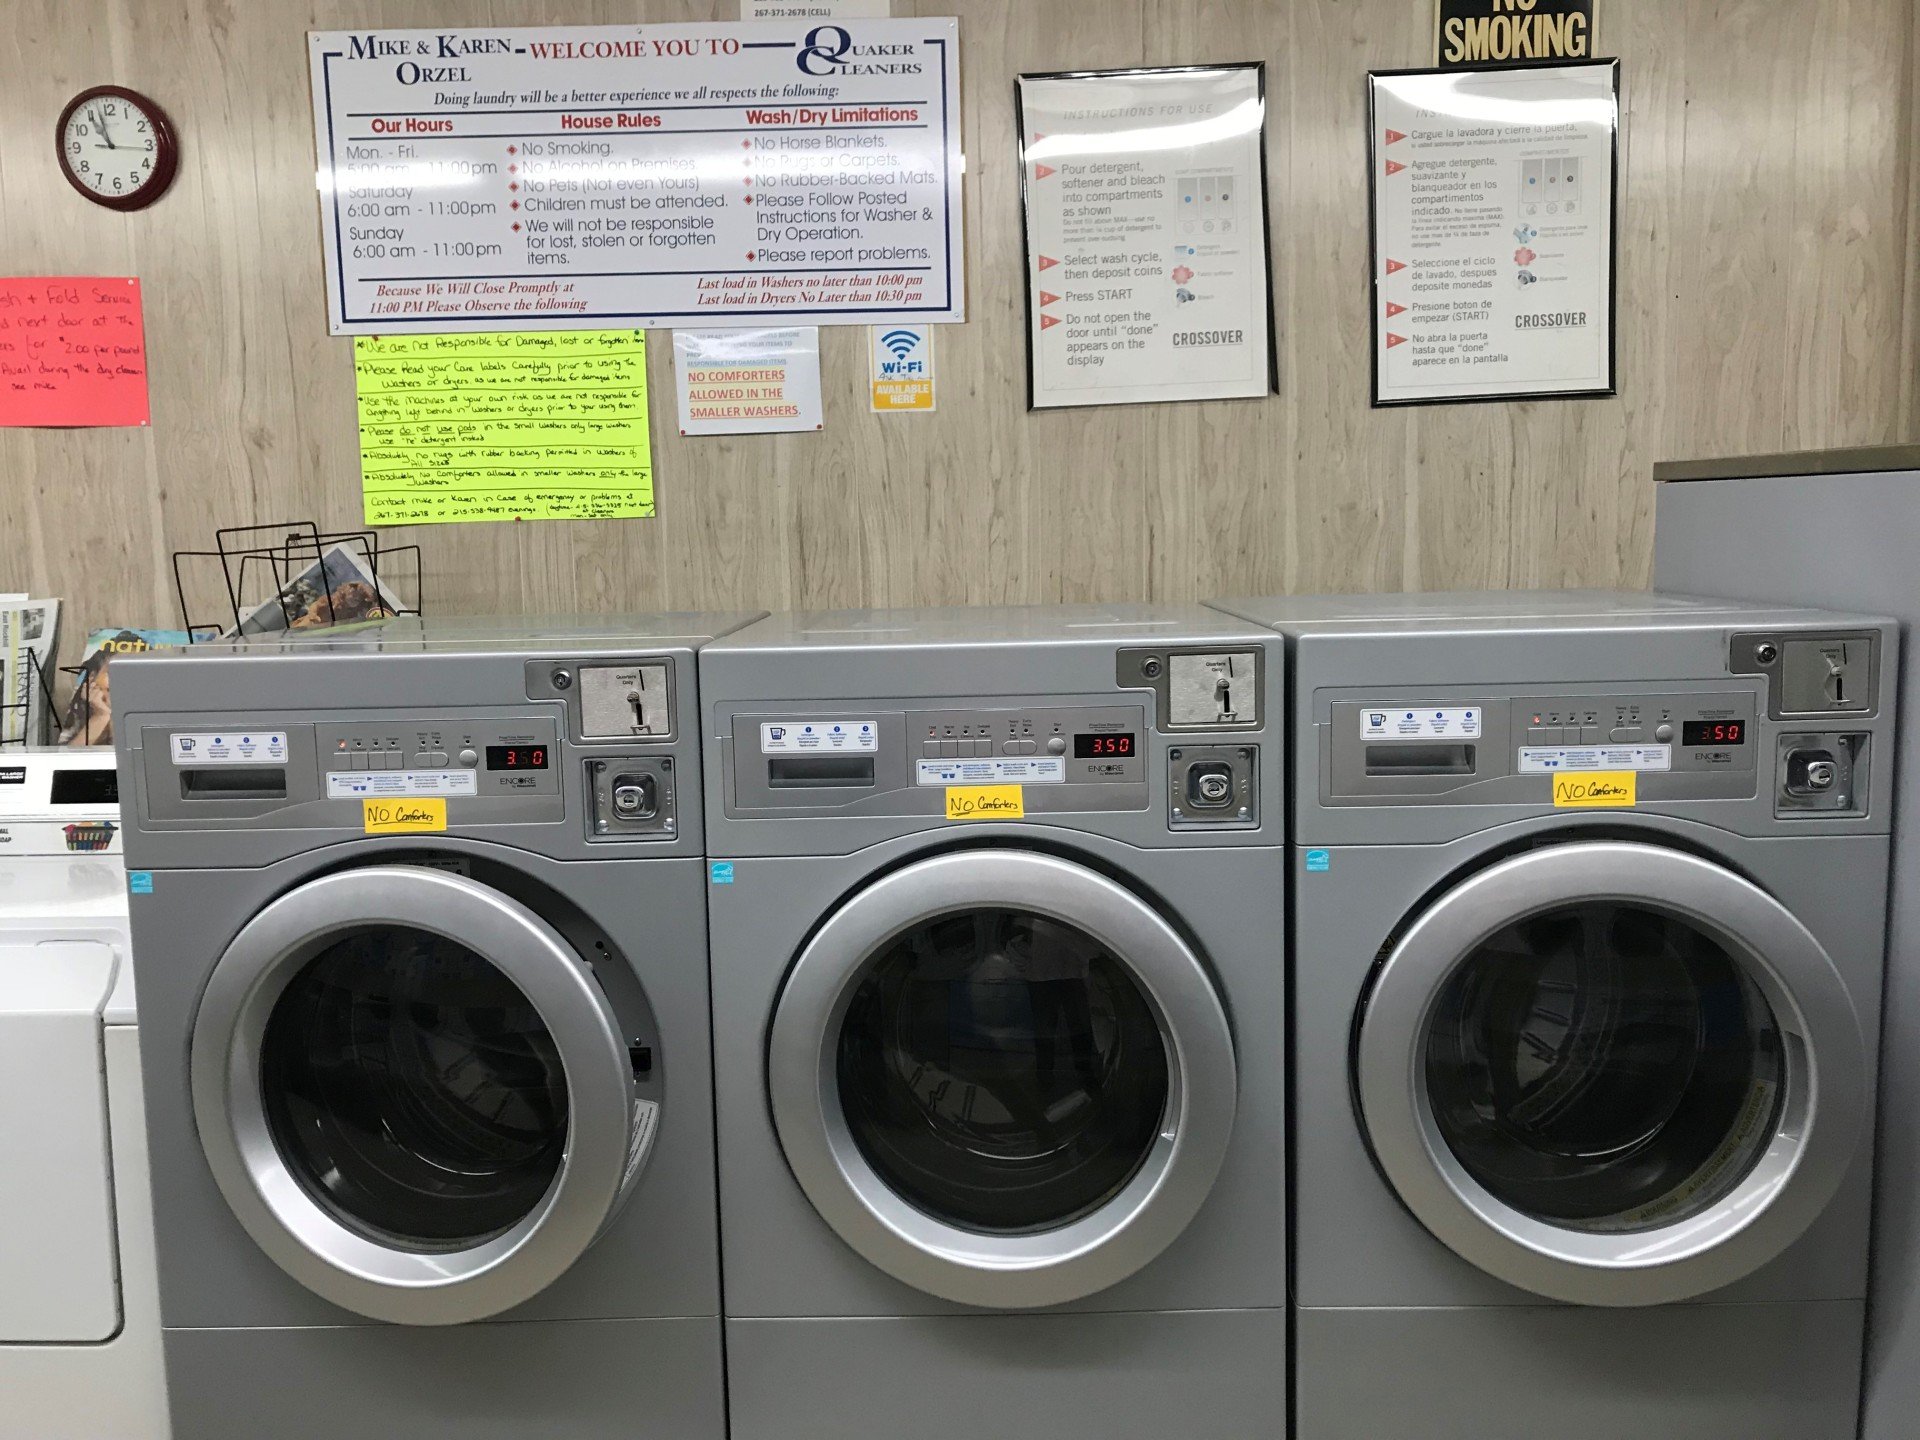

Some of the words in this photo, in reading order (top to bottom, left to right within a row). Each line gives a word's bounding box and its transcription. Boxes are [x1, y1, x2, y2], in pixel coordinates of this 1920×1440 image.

[808, 8, 831, 17] (CELL)
[1444, 12, 1586, 62] SMOKING
[416, 40, 430, 55] &
[530, 41, 646, 60] WELCOME
[650, 39, 701, 57] YOU
[704, 38, 739, 55] TO
[434, 92, 469, 108] Doing
[473, 92, 517, 108] laundry
[520, 91, 541, 104] will
[544, 90, 559, 103] be
[561, 94, 568, 103] a
[570, 90, 606, 103] better
[609, 87, 672, 104] experience
[675, 90, 689, 100] we
[692, 87, 707, 99] all
[710, 86, 757, 102] respects
[760, 85, 779, 98] the
[782, 83, 839, 101] following:
[103, 103, 116, 117] 12
[124, 107, 129, 120] 1
[746, 109, 828, 126] Wash/Dry
[831, 107, 918, 123] Limitations
[136, 120, 146, 133] 2
[371, 118, 401, 133] Our
[405, 118, 453, 133] Hours
[561, 114, 613, 129] House
[617, 113, 662, 128] Rules
[75, 124, 89, 137] 10
[72, 141, 82, 154] 9
[144, 139, 154, 152] 3
[522, 142, 544, 156] No
[547, 140, 614, 158] Smoking.
[80, 160, 90, 173] 8
[141, 157, 151, 170] 4
[1061, 163, 1086, 175] Pour
[1089, 162, 1144, 175] detergent,
[95, 172, 104, 185] 7
[112, 177, 122, 190] 6
[130, 171, 140, 184] 5
[1062, 178, 1103, 189] softener
[1106, 176, 1127, 187] and
[1130, 174, 1166, 186] bleach
[524, 197, 586, 212] Children
[590, 198, 626, 210] must
[630, 196, 650, 209] be
[655, 194, 728, 209] attended.
[756, 193, 804, 207] Please
[808, 192, 854, 206] Follow
[858, 191, 907, 205] Posted
[1062, 192, 1083, 203] into
[1086, 189, 1163, 203] compartments
[347, 203, 380, 218] 6:00
[385, 206, 410, 217] am
[756, 209, 837, 224] Instructions
[840, 209, 860, 222] for
[864, 207, 917, 222] Washer
[922, 207, 933, 221] &
[1062, 208, 1075, 217] as
[1078, 205, 1112, 216] shown
[525, 219, 549, 233] We
[552, 218, 574, 232] will
[578, 218, 602, 232] not
[605, 217, 627, 231] be
[631, 215, 714, 233] responsible
[349, 227, 404, 242] Sunday
[526, 235, 545, 249] for
[549, 235, 577, 250] lost,
[582, 233, 624, 248] stolen
[629, 237, 646, 247] or
[648, 232, 716, 249] forgotten
[353, 244, 386, 259] 6:00
[390, 247, 416, 258] am
[527, 251, 570, 265] items.
[1064, 254, 1098, 266] Select
[1101, 253, 1128, 264] wash
[1131, 251, 1163, 265] cycle,
[1411, 258, 1460, 269] Seleccione
[1462, 257, 1471, 267] el
[1473, 257, 1496, 267] ciclo
[1064, 268, 1088, 280] then
[1091, 267, 1131, 280] deposit
[1134, 266, 1163, 277] coins
[1411, 270, 1423, 280] de
[1426, 269, 1457, 280] lavado,
[1460, 268, 1497, 279] despues
[1411, 281, 1450, 293] deposite
[1452, 280, 1493, 290] monedas
[1065, 291, 1095, 302] Press
[1097, 288, 1133, 301] START
[1515, 311, 1587, 328] CROSSOVER
[1172, 329, 1244, 347] CROSSOVER
[1412, 334, 1425, 343] No
[1427, 333, 1447, 343] abra
[1449, 332, 1457, 342] la
[1460, 332, 1488, 343] puerta
[882, 360, 922, 373] Wi-Fi
[688, 371, 705, 382] NO
[708, 369, 785, 382] COMFORTERS
[689, 388, 743, 400] ALLOWED
[746, 388, 758, 399] IN
[761, 388, 783, 398] THE
[877, 383, 930, 395] AVAILABLE
[890, 394, 916, 404] HERE
[690, 406, 741, 418] SMALLER
[743, 405, 802, 416] WASHERS.
[1093, 738, 1130, 753] 3.50
[1695, 752, 1732, 761] ENCORE
[1088, 764, 1124, 773] ENCORE
[499, 776, 536, 785] ENCORE
[367, 808, 390, 823] NO
